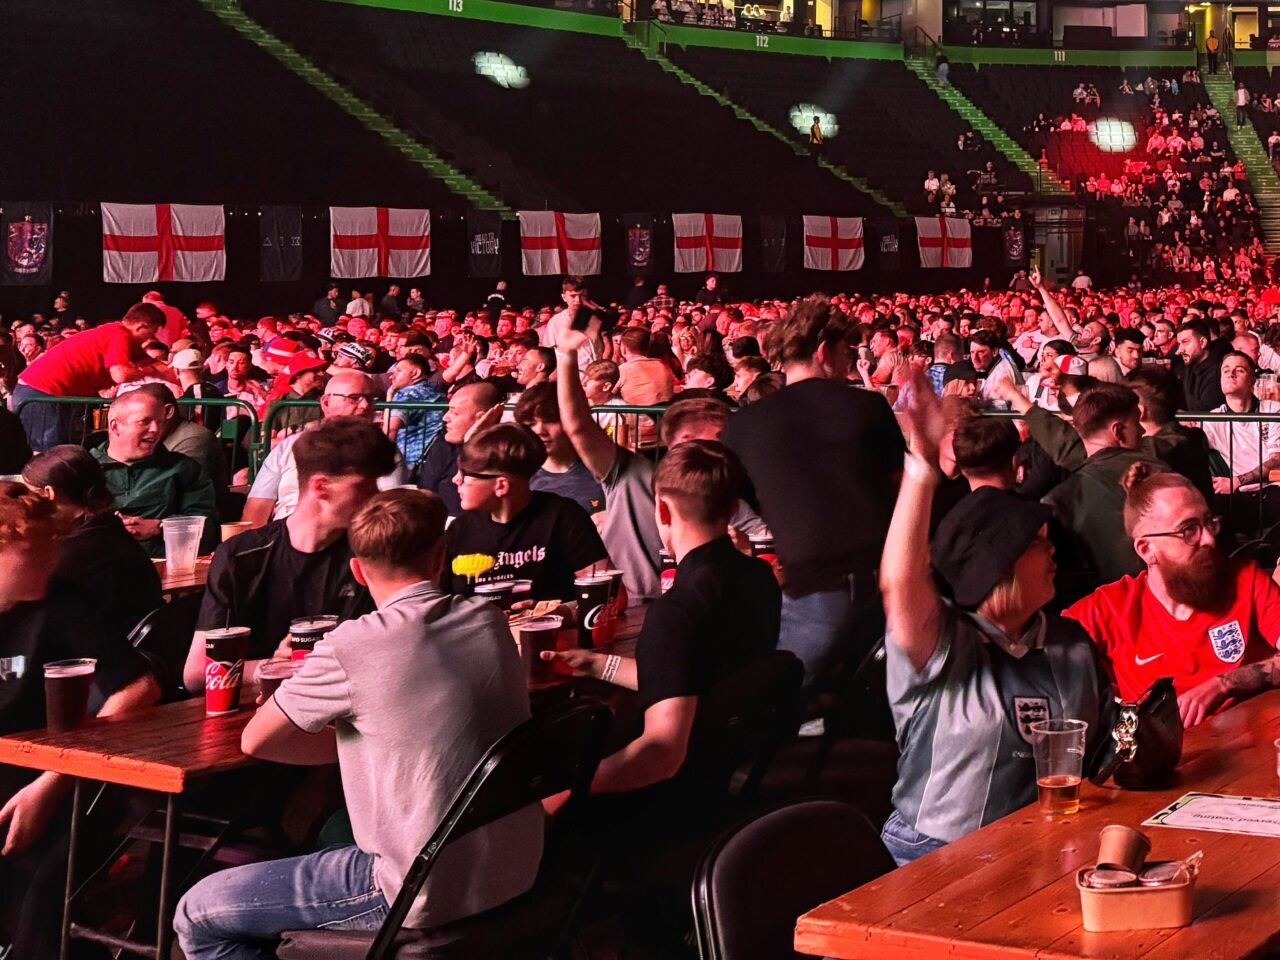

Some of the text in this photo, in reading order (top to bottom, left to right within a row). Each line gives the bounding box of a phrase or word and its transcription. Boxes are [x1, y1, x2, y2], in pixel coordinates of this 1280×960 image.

[756, 35, 769, 48] 112
[1054, 50, 1066, 61] 111
[470, 238, 499, 255] VICTORY
[494, 545, 546, 569] Angels
